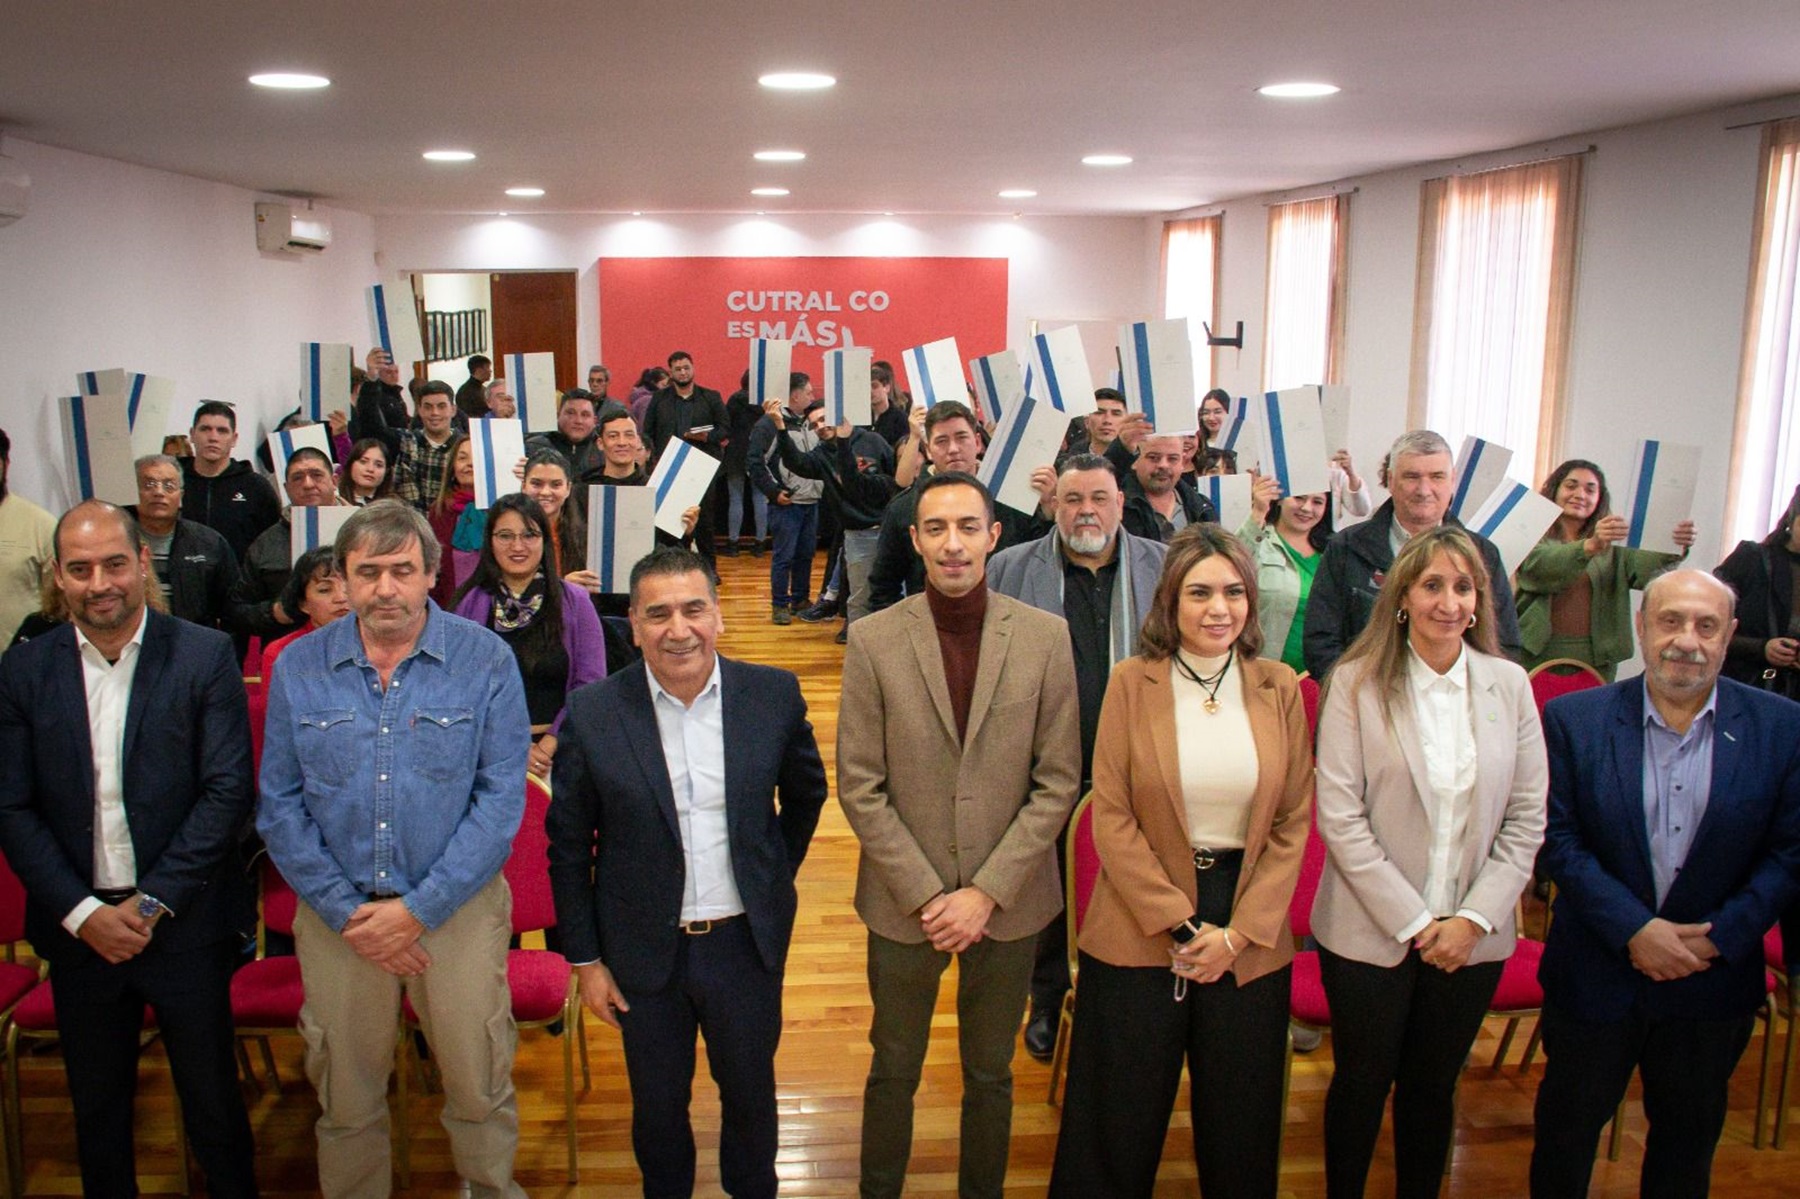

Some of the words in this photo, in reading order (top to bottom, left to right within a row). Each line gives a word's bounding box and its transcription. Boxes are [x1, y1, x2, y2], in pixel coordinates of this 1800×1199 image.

[727, 290, 841, 312] CUTRAL
[849, 290, 889, 312] CO
[727, 321, 755, 338] ES
[759, 313, 837, 347] MÁS
